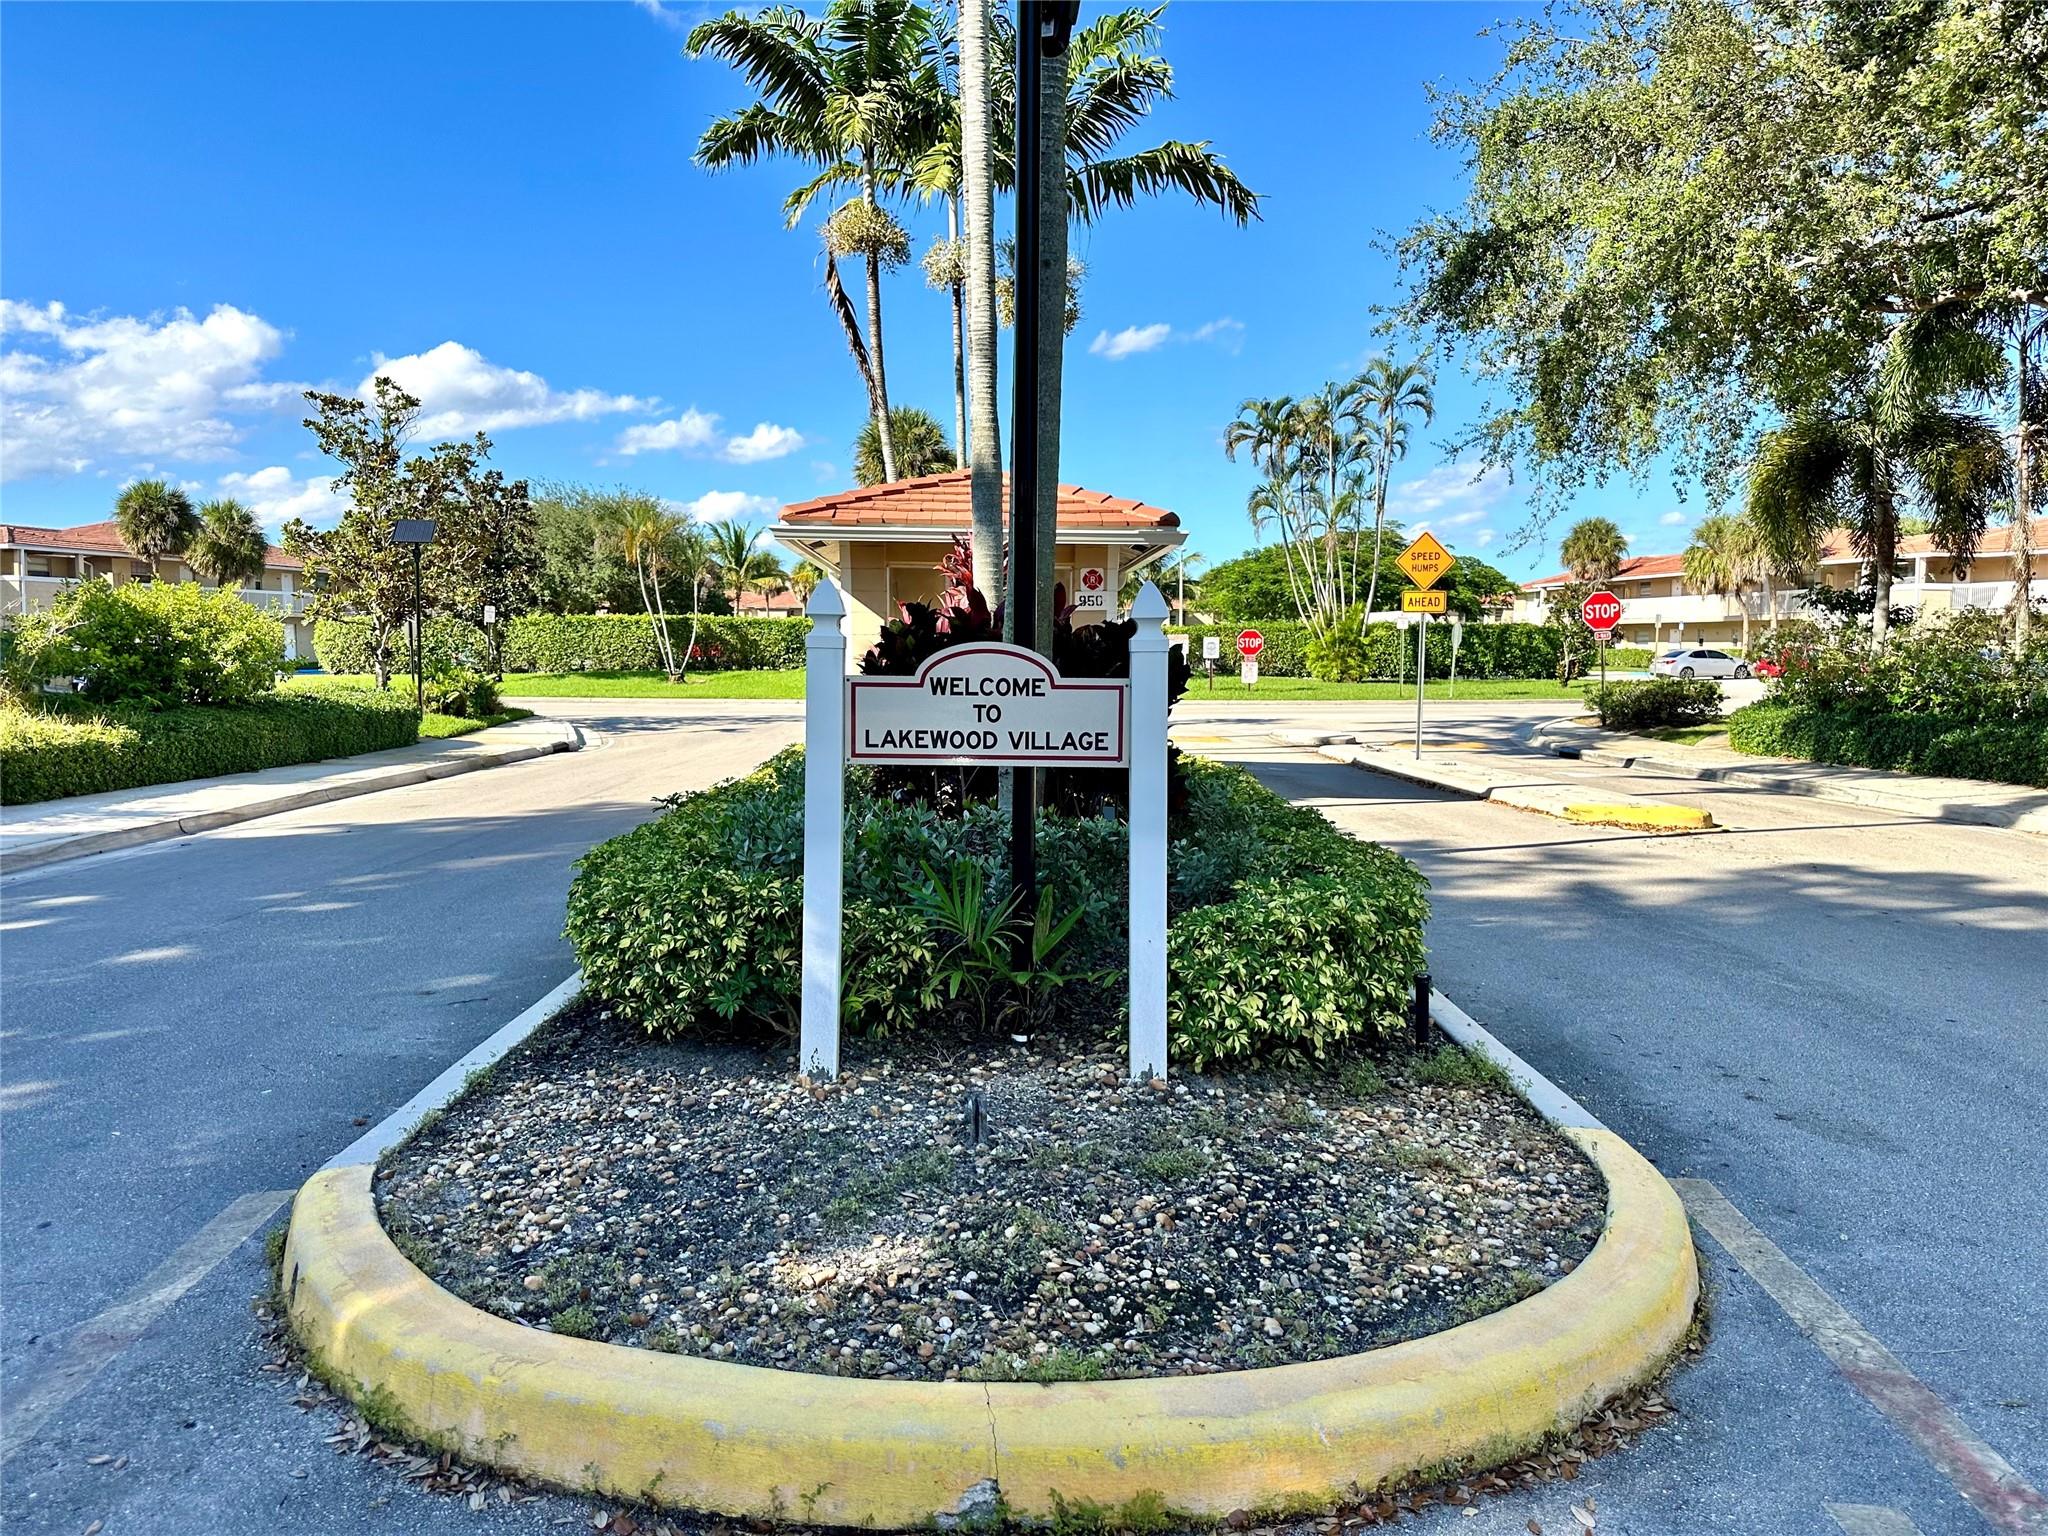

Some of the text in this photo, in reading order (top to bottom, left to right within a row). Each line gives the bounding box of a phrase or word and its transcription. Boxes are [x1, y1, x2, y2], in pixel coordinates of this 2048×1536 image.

[1411, 552, 1441, 561] SPEED
[1411, 564, 1439, 572] HUMPS
[1090, 575, 1096, 584] R
[1079, 595, 1103, 606] 950
[1408, 597, 1441, 607] AHEAD
[1585, 603, 1620, 619] STOP
[1239, 637, 1262, 649] STOP
[930, 677, 1046, 697] WELCOME
[973, 704, 1002, 723] TO
[865, 730, 1109, 751] LAKEWOOD VILLAGE
